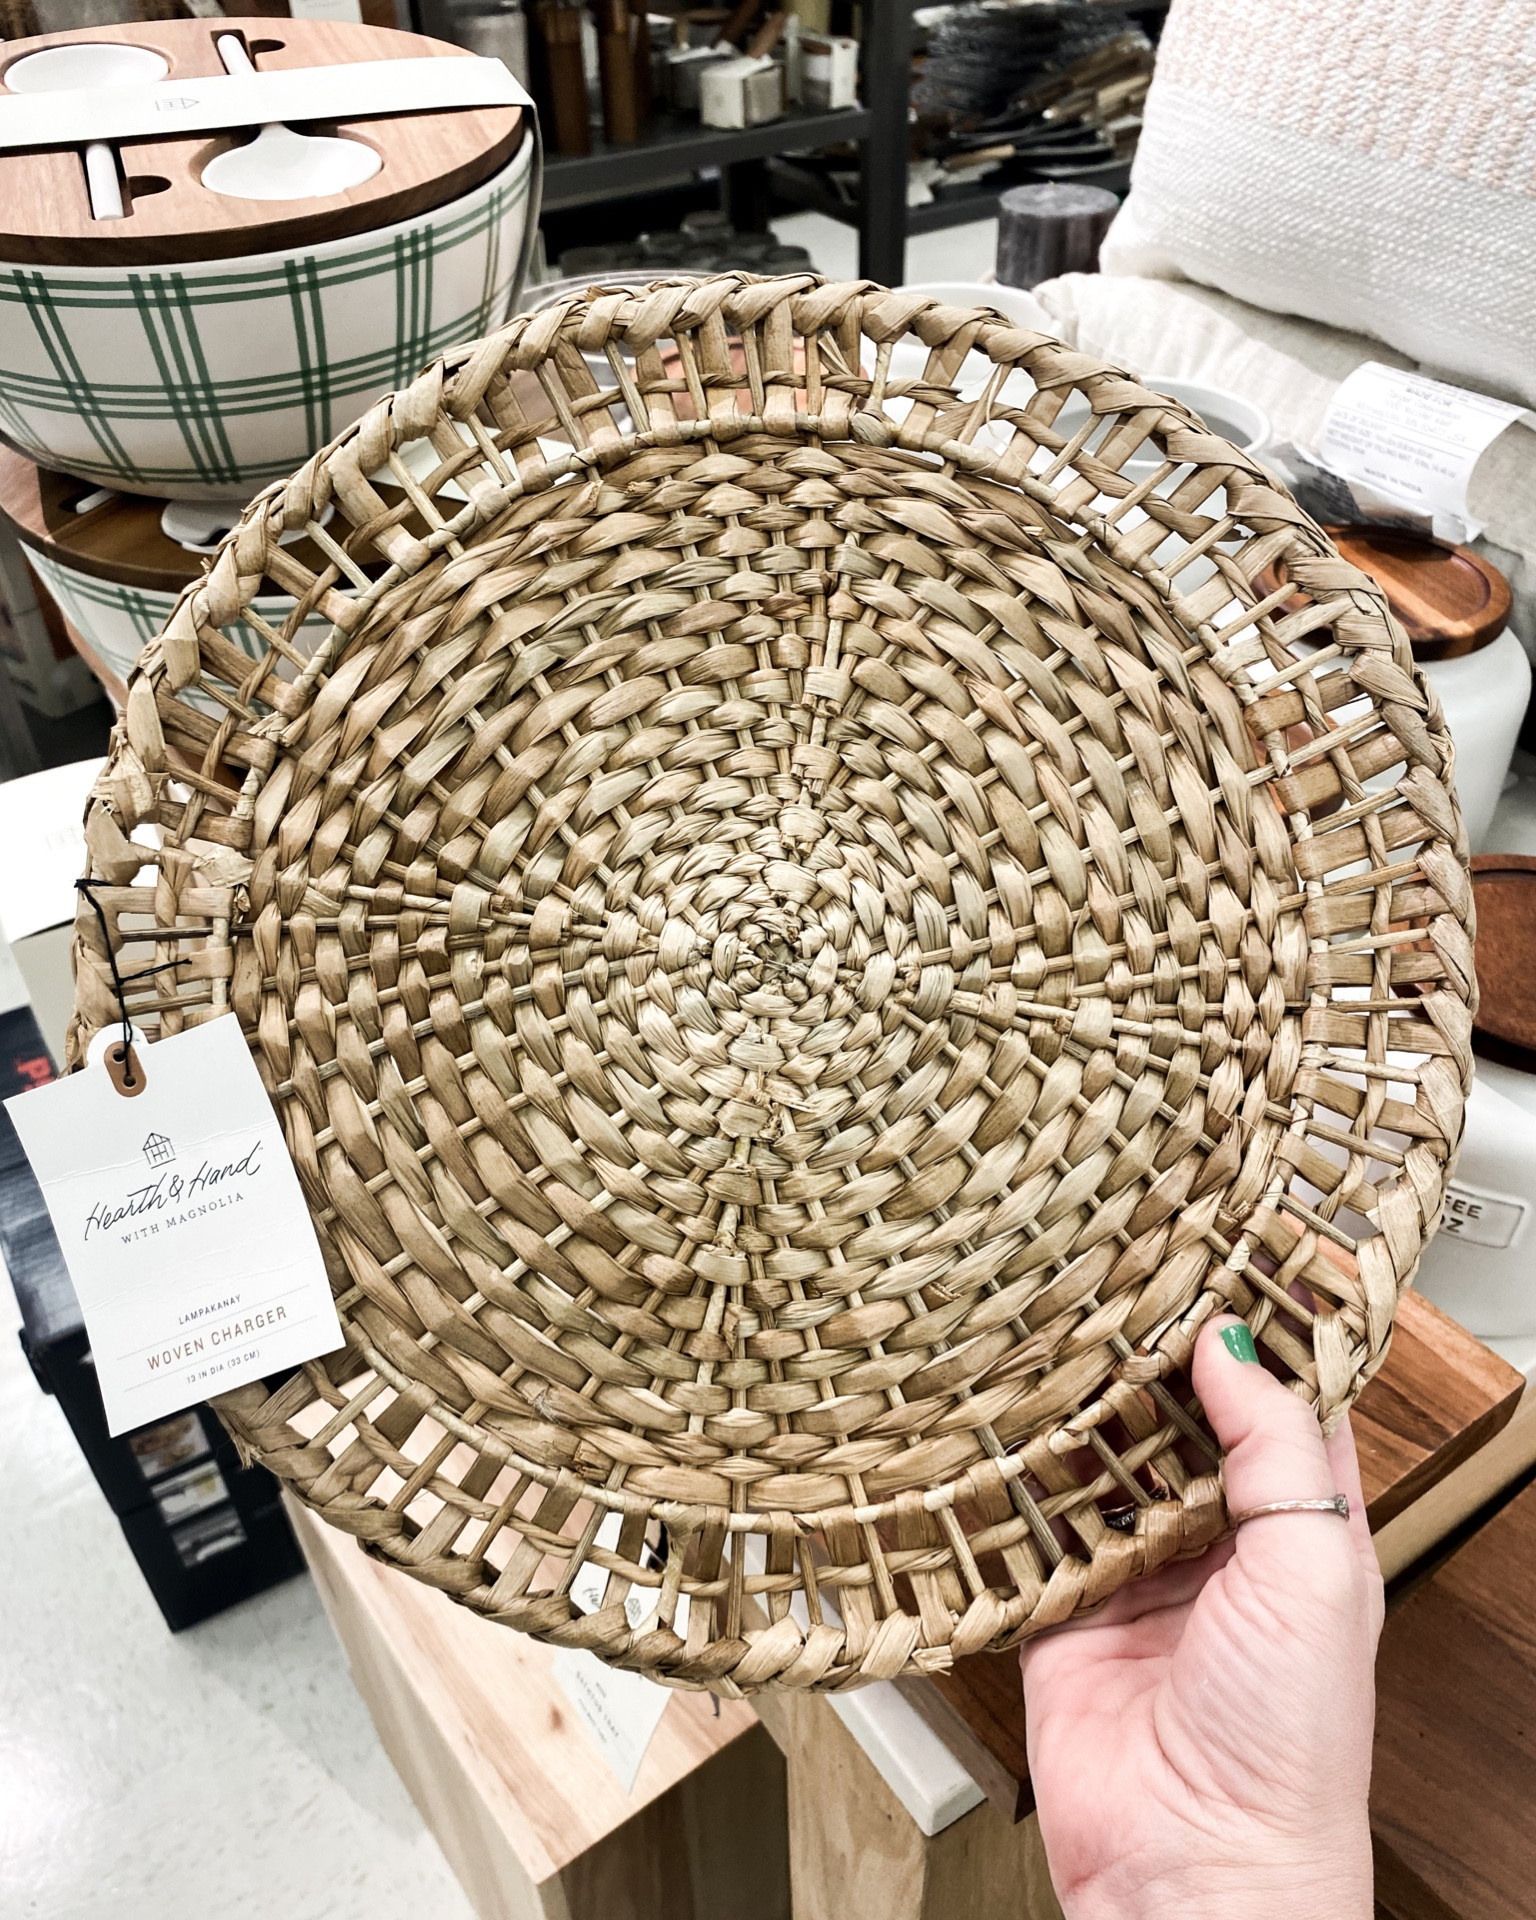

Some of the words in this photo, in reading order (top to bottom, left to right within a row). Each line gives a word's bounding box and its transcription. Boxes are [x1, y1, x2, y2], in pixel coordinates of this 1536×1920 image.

[84, 1172, 169, 1241] Hearth
[168, 1174, 185, 1204] &
[187, 1140, 262, 1198] Hand
[121, 1223, 160, 1244] WITH
[166, 1192, 245, 1228] MAGNOLIA
[178, 1294, 241, 1325] LAMPAKANAY
[147, 1337, 204, 1370] WOVEN
[211, 1305, 287, 1346] CHARGER
[187, 1374, 197, 1384] 13
[198, 1370, 208, 1379] IN
[210, 1364, 225, 1375] DIA
[227, 1356, 242, 1369] (33
[244, 1349, 260, 1362] CM)
